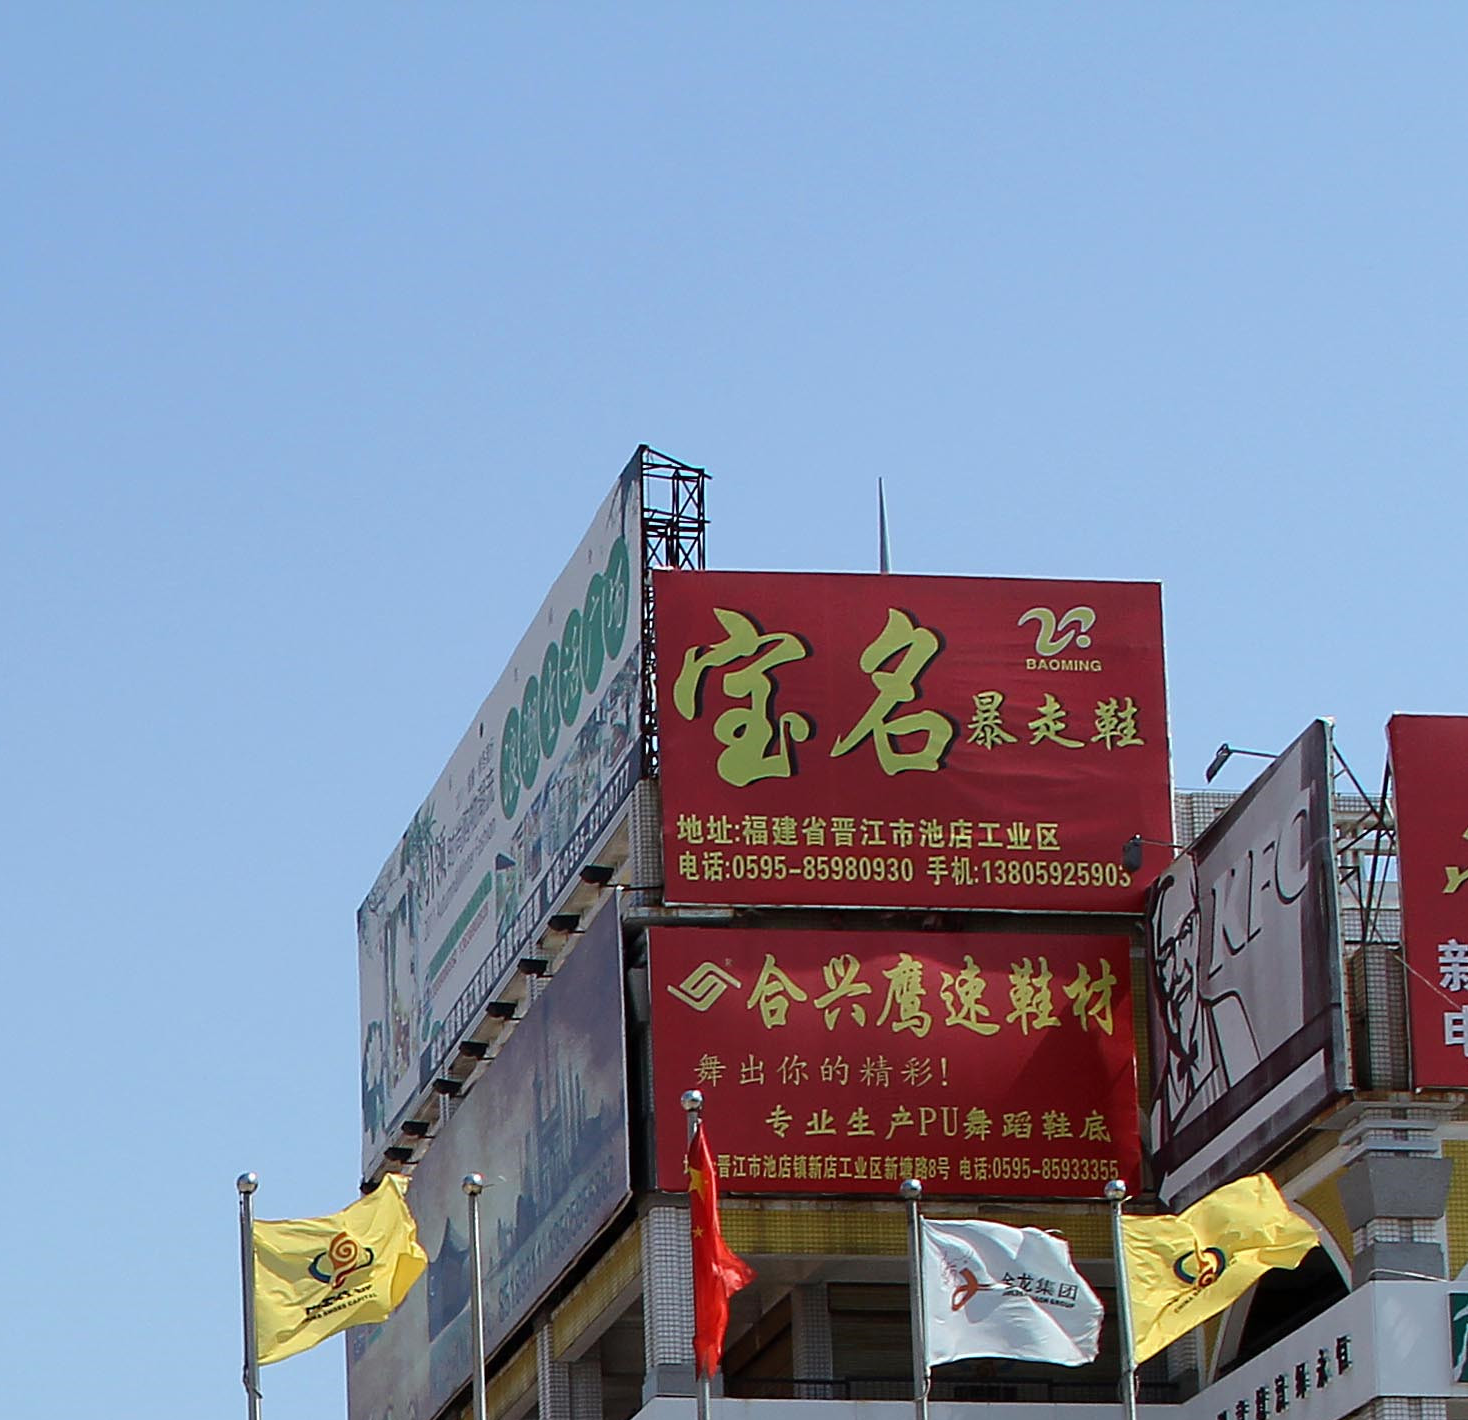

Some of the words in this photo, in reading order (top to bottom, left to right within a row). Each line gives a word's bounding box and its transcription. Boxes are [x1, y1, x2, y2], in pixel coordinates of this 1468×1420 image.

[1026, 657, 1103, 672] BAOMING
[673, 607, 957, 787] 宝名
[966, 690, 1146, 750] 暴走鞋
[677, 815, 1062, 852] 地址:福建省晋江市池店工业区
[678, 852, 914, 883] 电话:0595-85980930
[926, 856, 1133, 888] 手机:13805925903
[747, 953, 1118, 1038] 合兴鹰速鞋材
[694, 1053, 950, 1088] 舞出你的精彩!
[765, 1105, 1112, 1142] 专业生产PU舞蹈鞋底
[683, 1154, 951, 1182] :晋江市池店镇新店工业区新塘路8号
[960, 1157, 1120, 1181] 电话:0595-85933355
